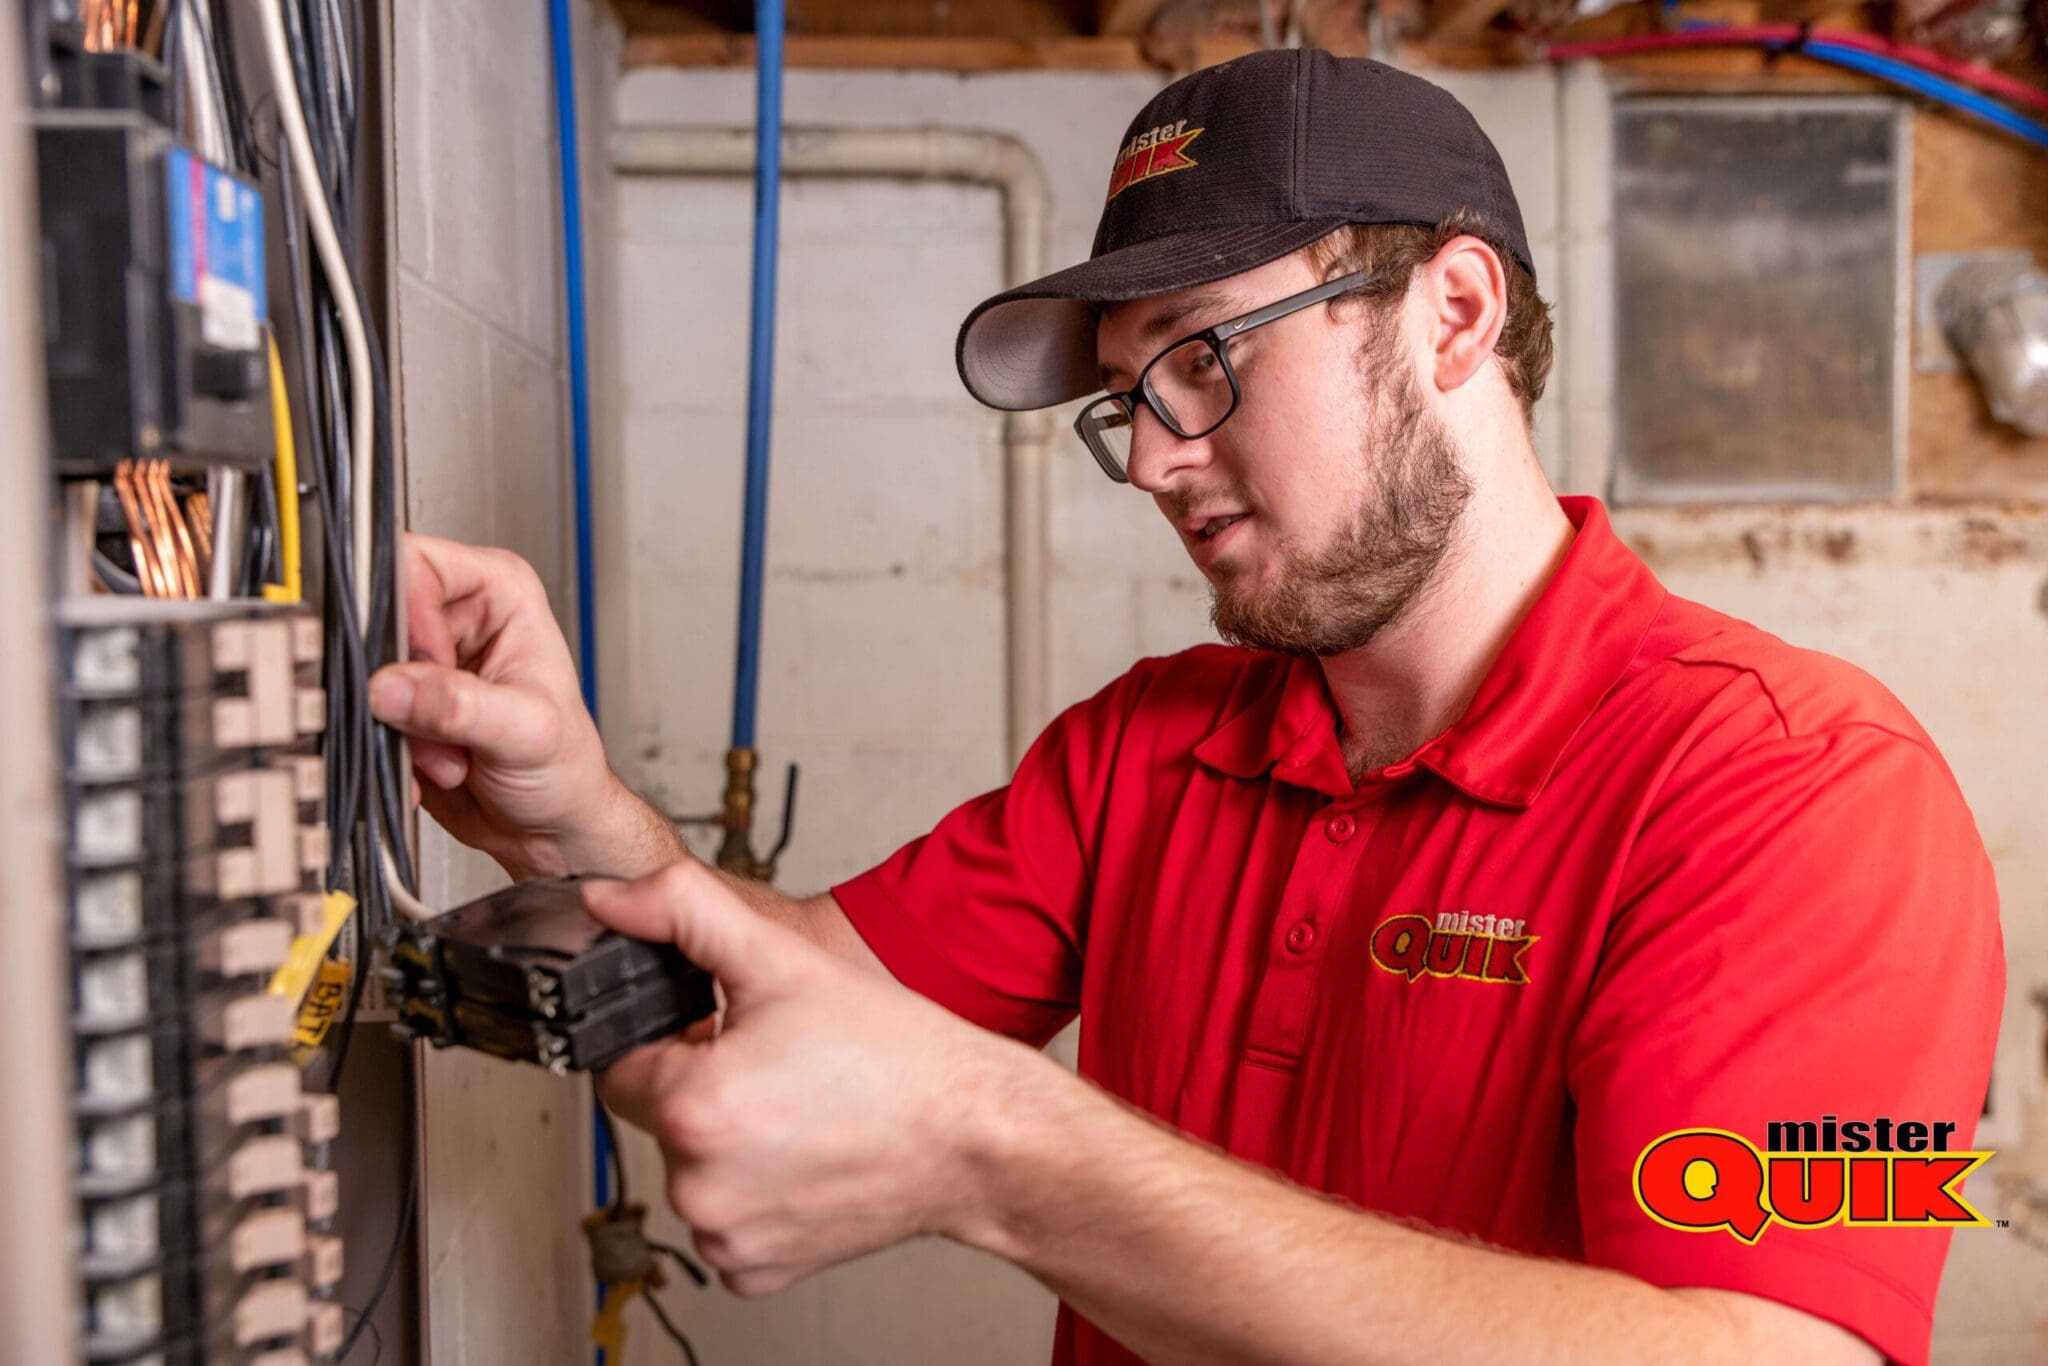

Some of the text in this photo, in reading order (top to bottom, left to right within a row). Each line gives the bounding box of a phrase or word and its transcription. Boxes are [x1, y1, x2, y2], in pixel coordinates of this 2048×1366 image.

[1107, 127, 1206, 201] UIK
[1370, 914, 1541, 984] QUIK
[1436, 910, 1526, 938] mister
